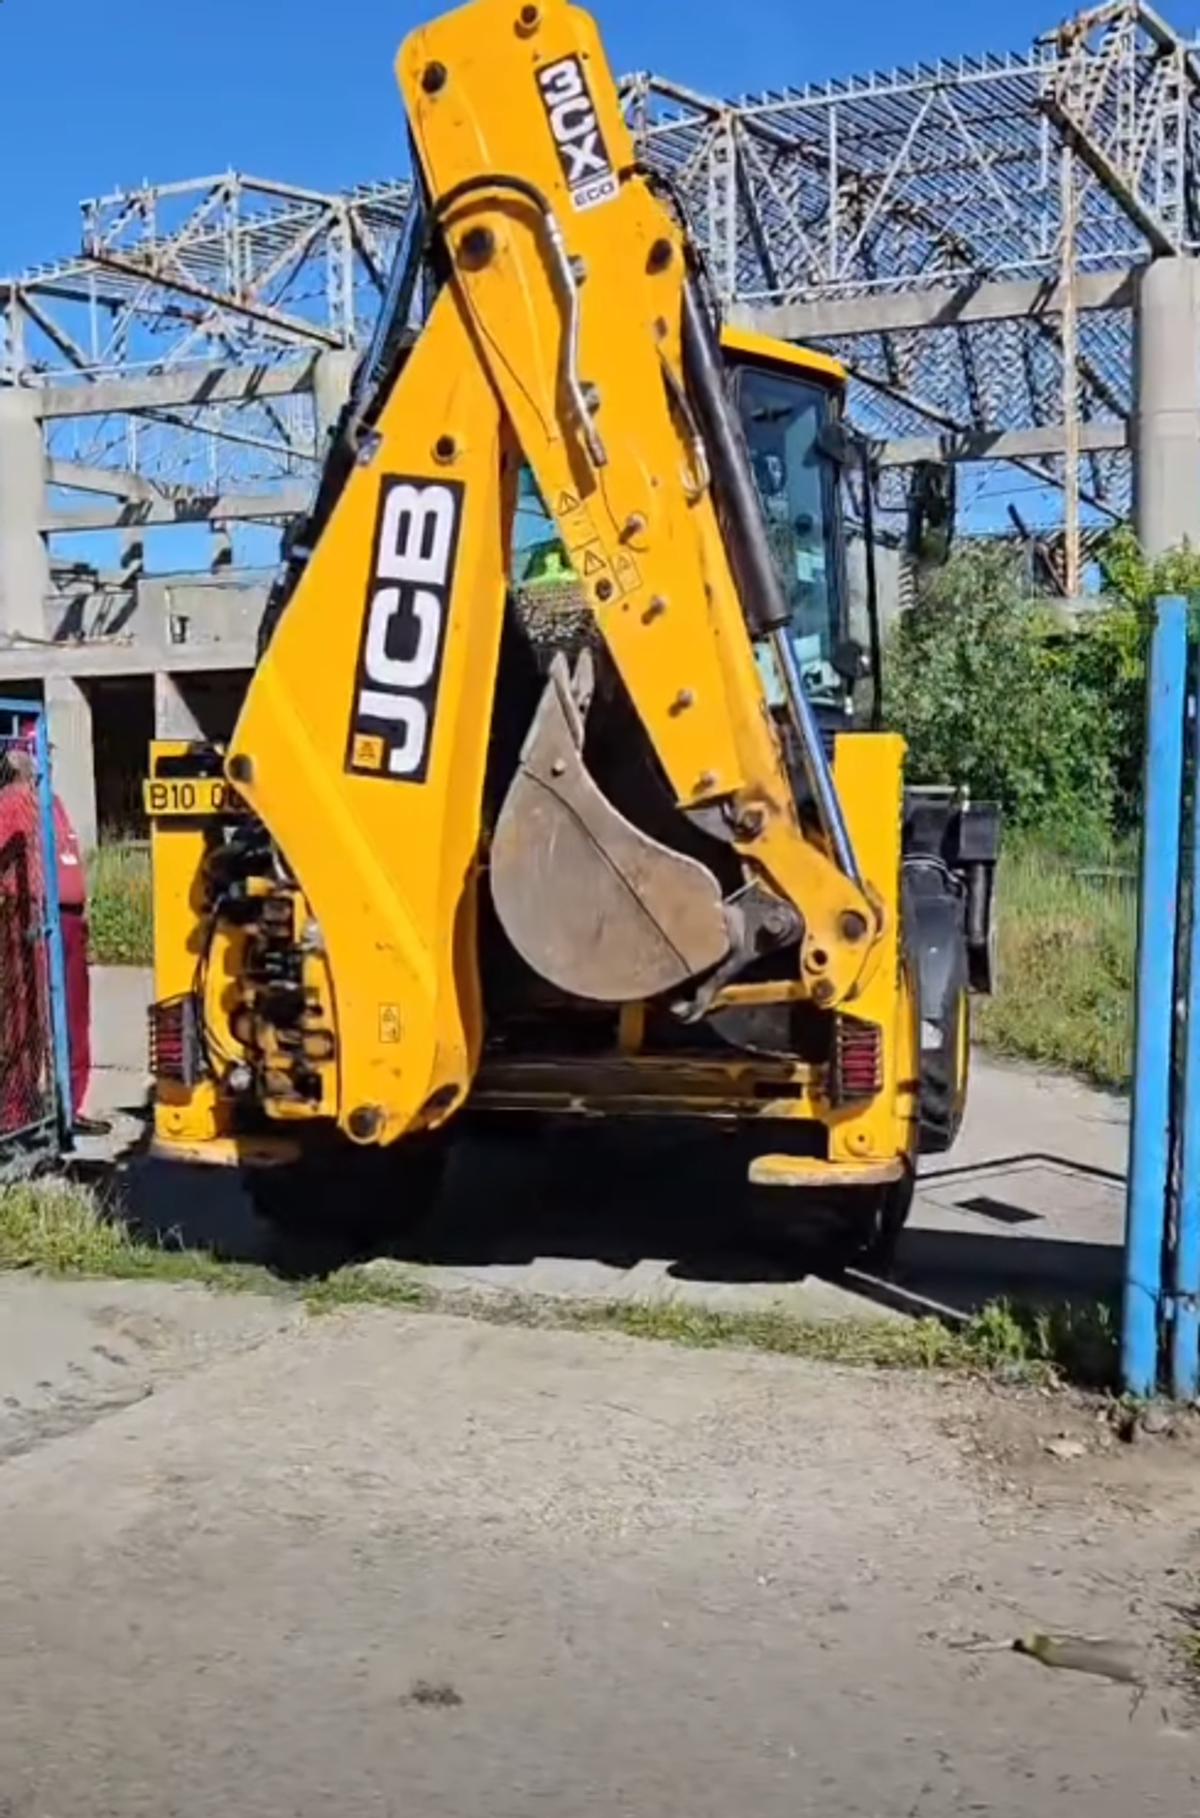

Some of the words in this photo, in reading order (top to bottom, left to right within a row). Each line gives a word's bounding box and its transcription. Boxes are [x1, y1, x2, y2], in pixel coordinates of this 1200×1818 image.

[539, 59, 608, 182] 3CX
[574, 181, 615, 206] ECO
[358, 484, 456, 774] JCB
[150, 783, 196, 811] B10
